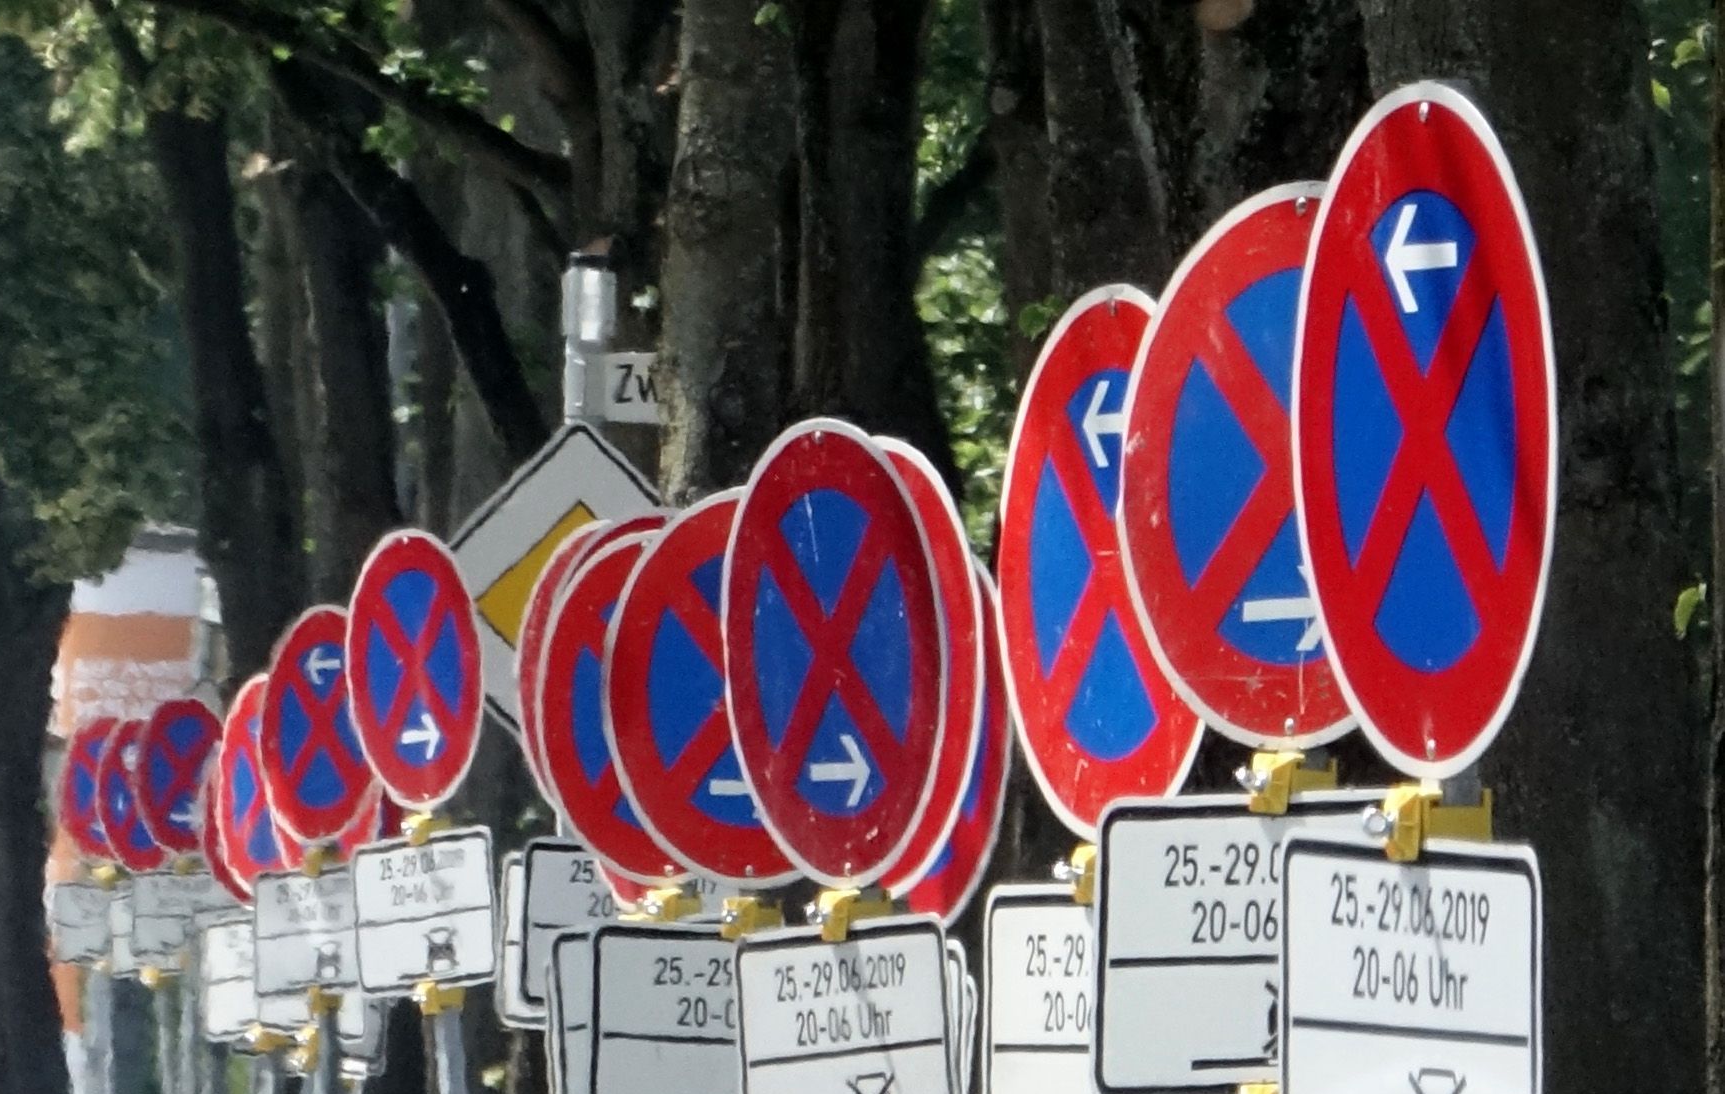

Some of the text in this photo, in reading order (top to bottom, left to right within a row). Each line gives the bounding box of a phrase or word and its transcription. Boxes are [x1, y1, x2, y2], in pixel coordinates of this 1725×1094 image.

[1191, 899, 1277, 944] 20-06
[1330, 871, 1491, 945] 25.-29.06.2019
[774, 952, 907, 1003] 25.-29.06.2019
[1353, 945, 1469, 1011] 20-06 Uhr
[795, 1001, 894, 1047] 20-06 Uhr
